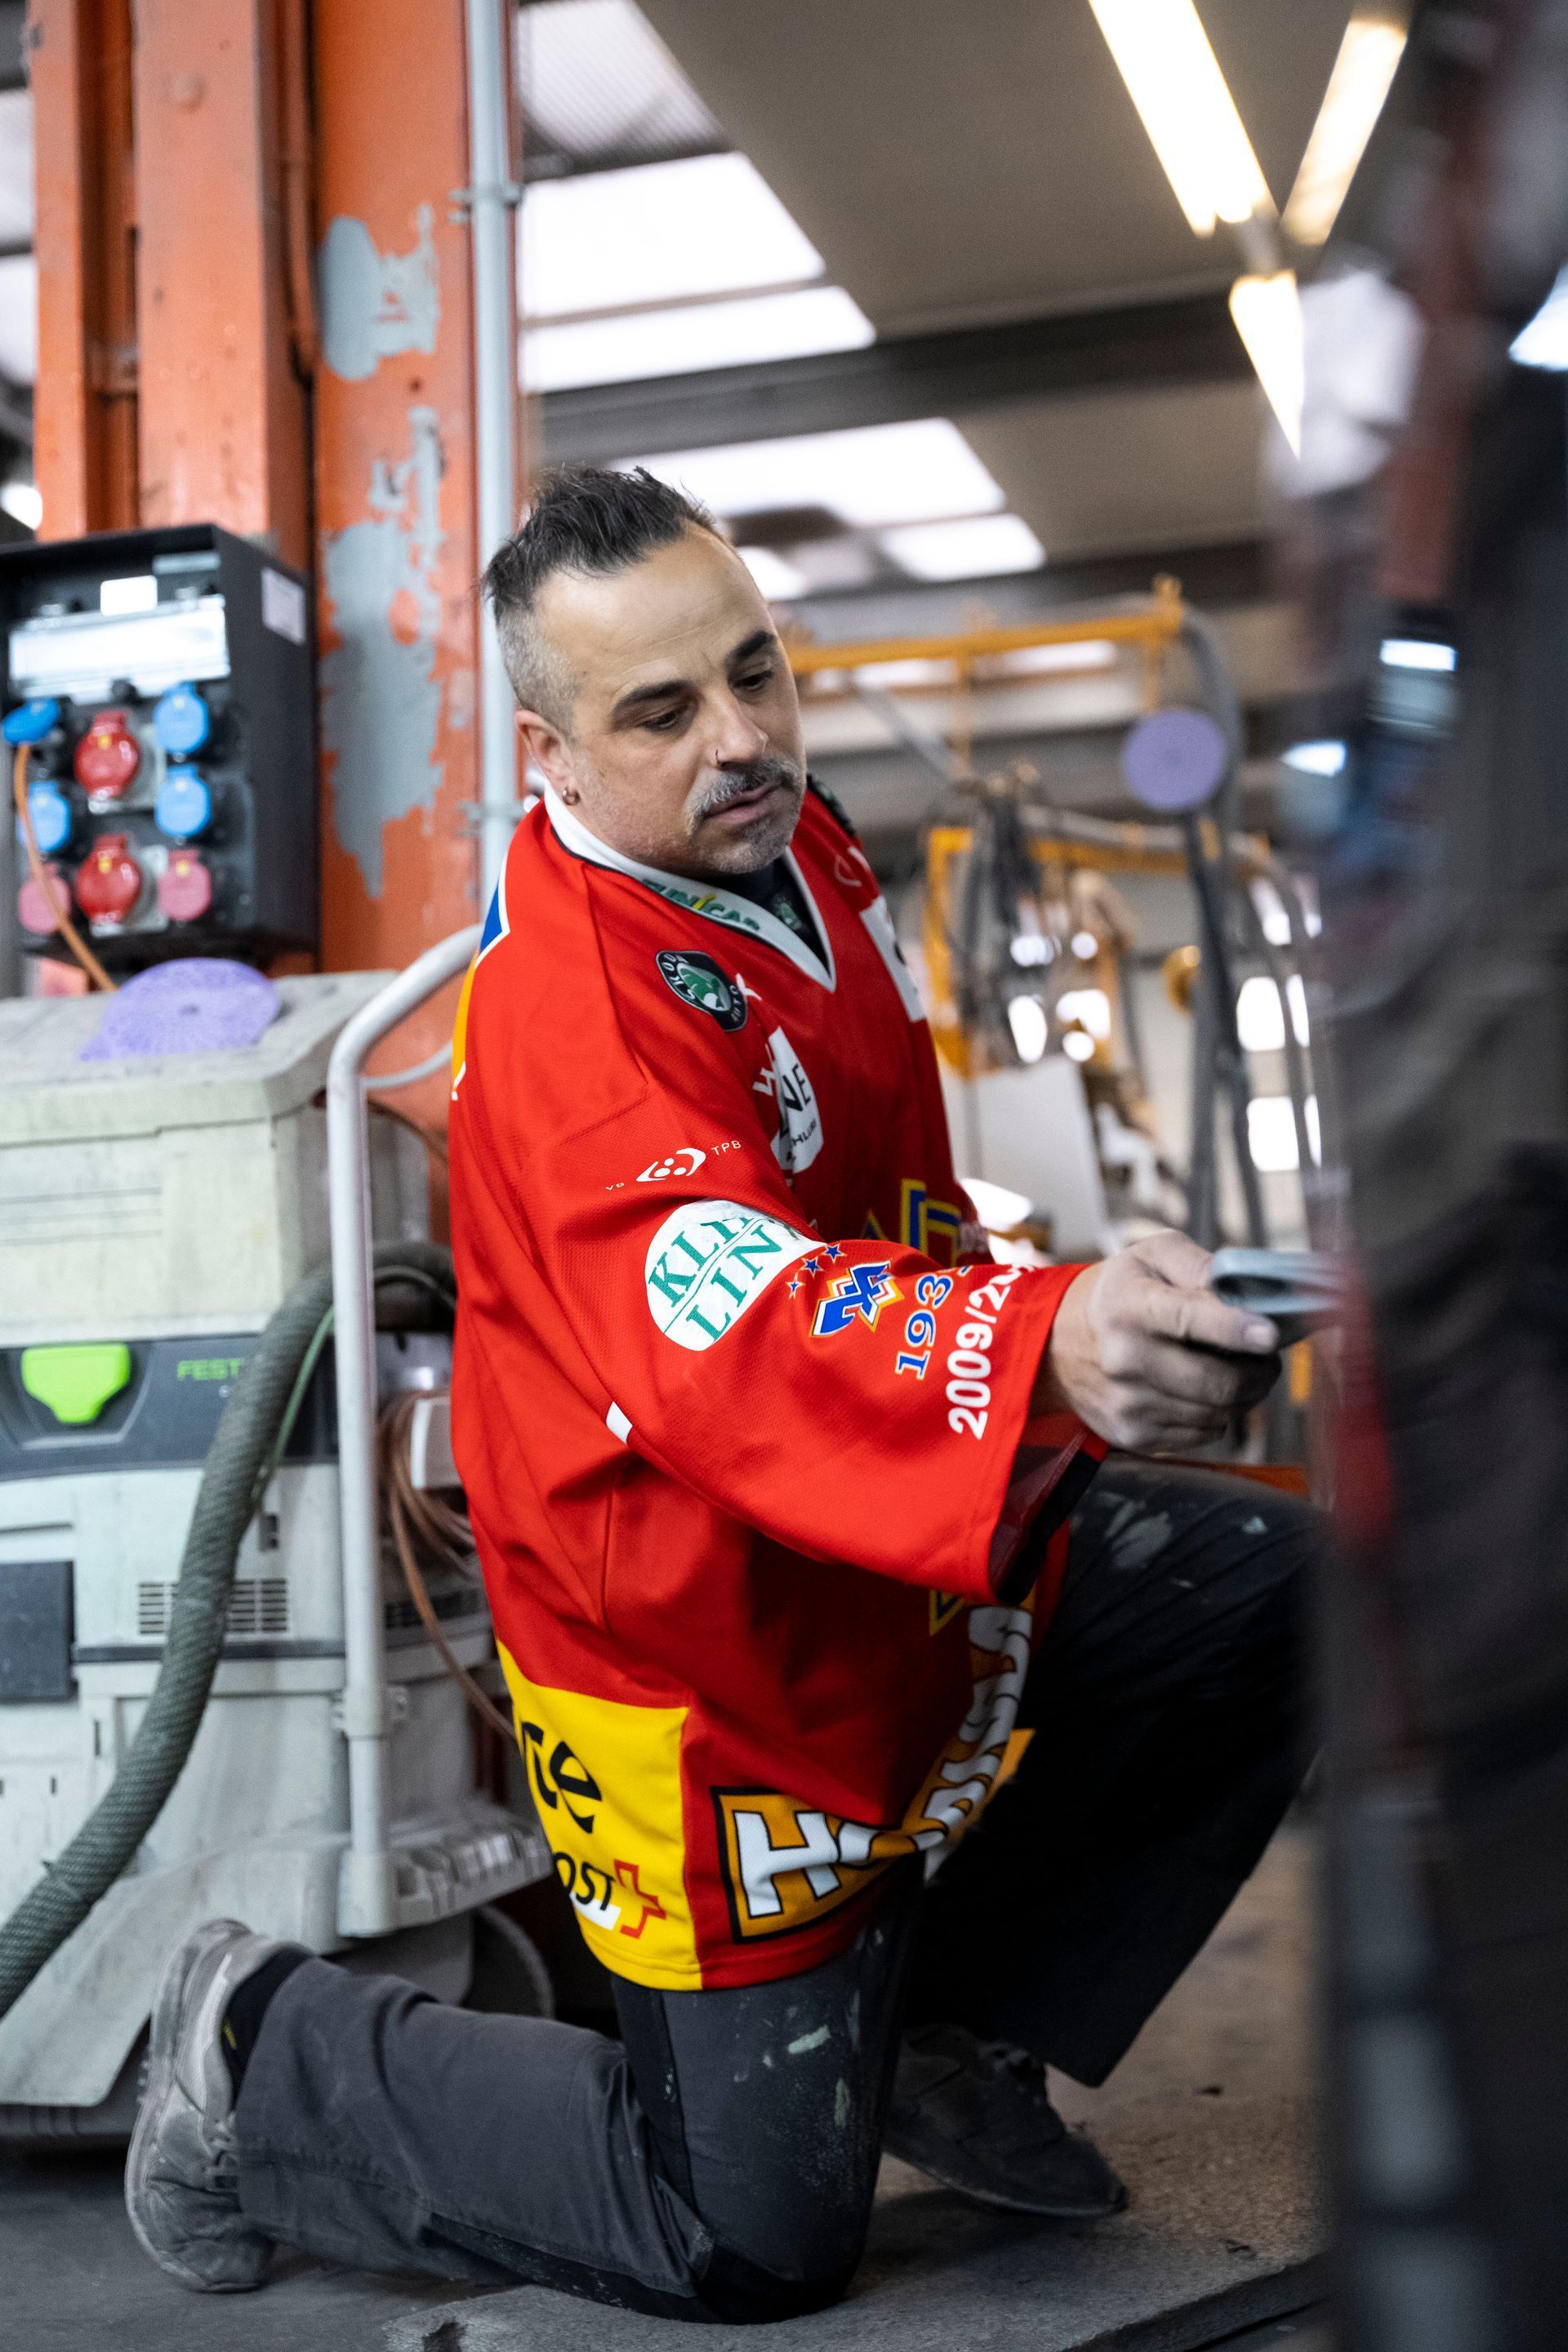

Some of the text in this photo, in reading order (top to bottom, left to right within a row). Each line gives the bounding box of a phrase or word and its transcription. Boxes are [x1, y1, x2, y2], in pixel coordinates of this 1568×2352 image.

[711, 1140, 742, 1156] TPB
[685, 1222, 800, 1343] LIN
[894, 1265, 973, 1380] 193
[176, 1358, 244, 1380] FEST
[553, 1851, 617, 1911] OST
